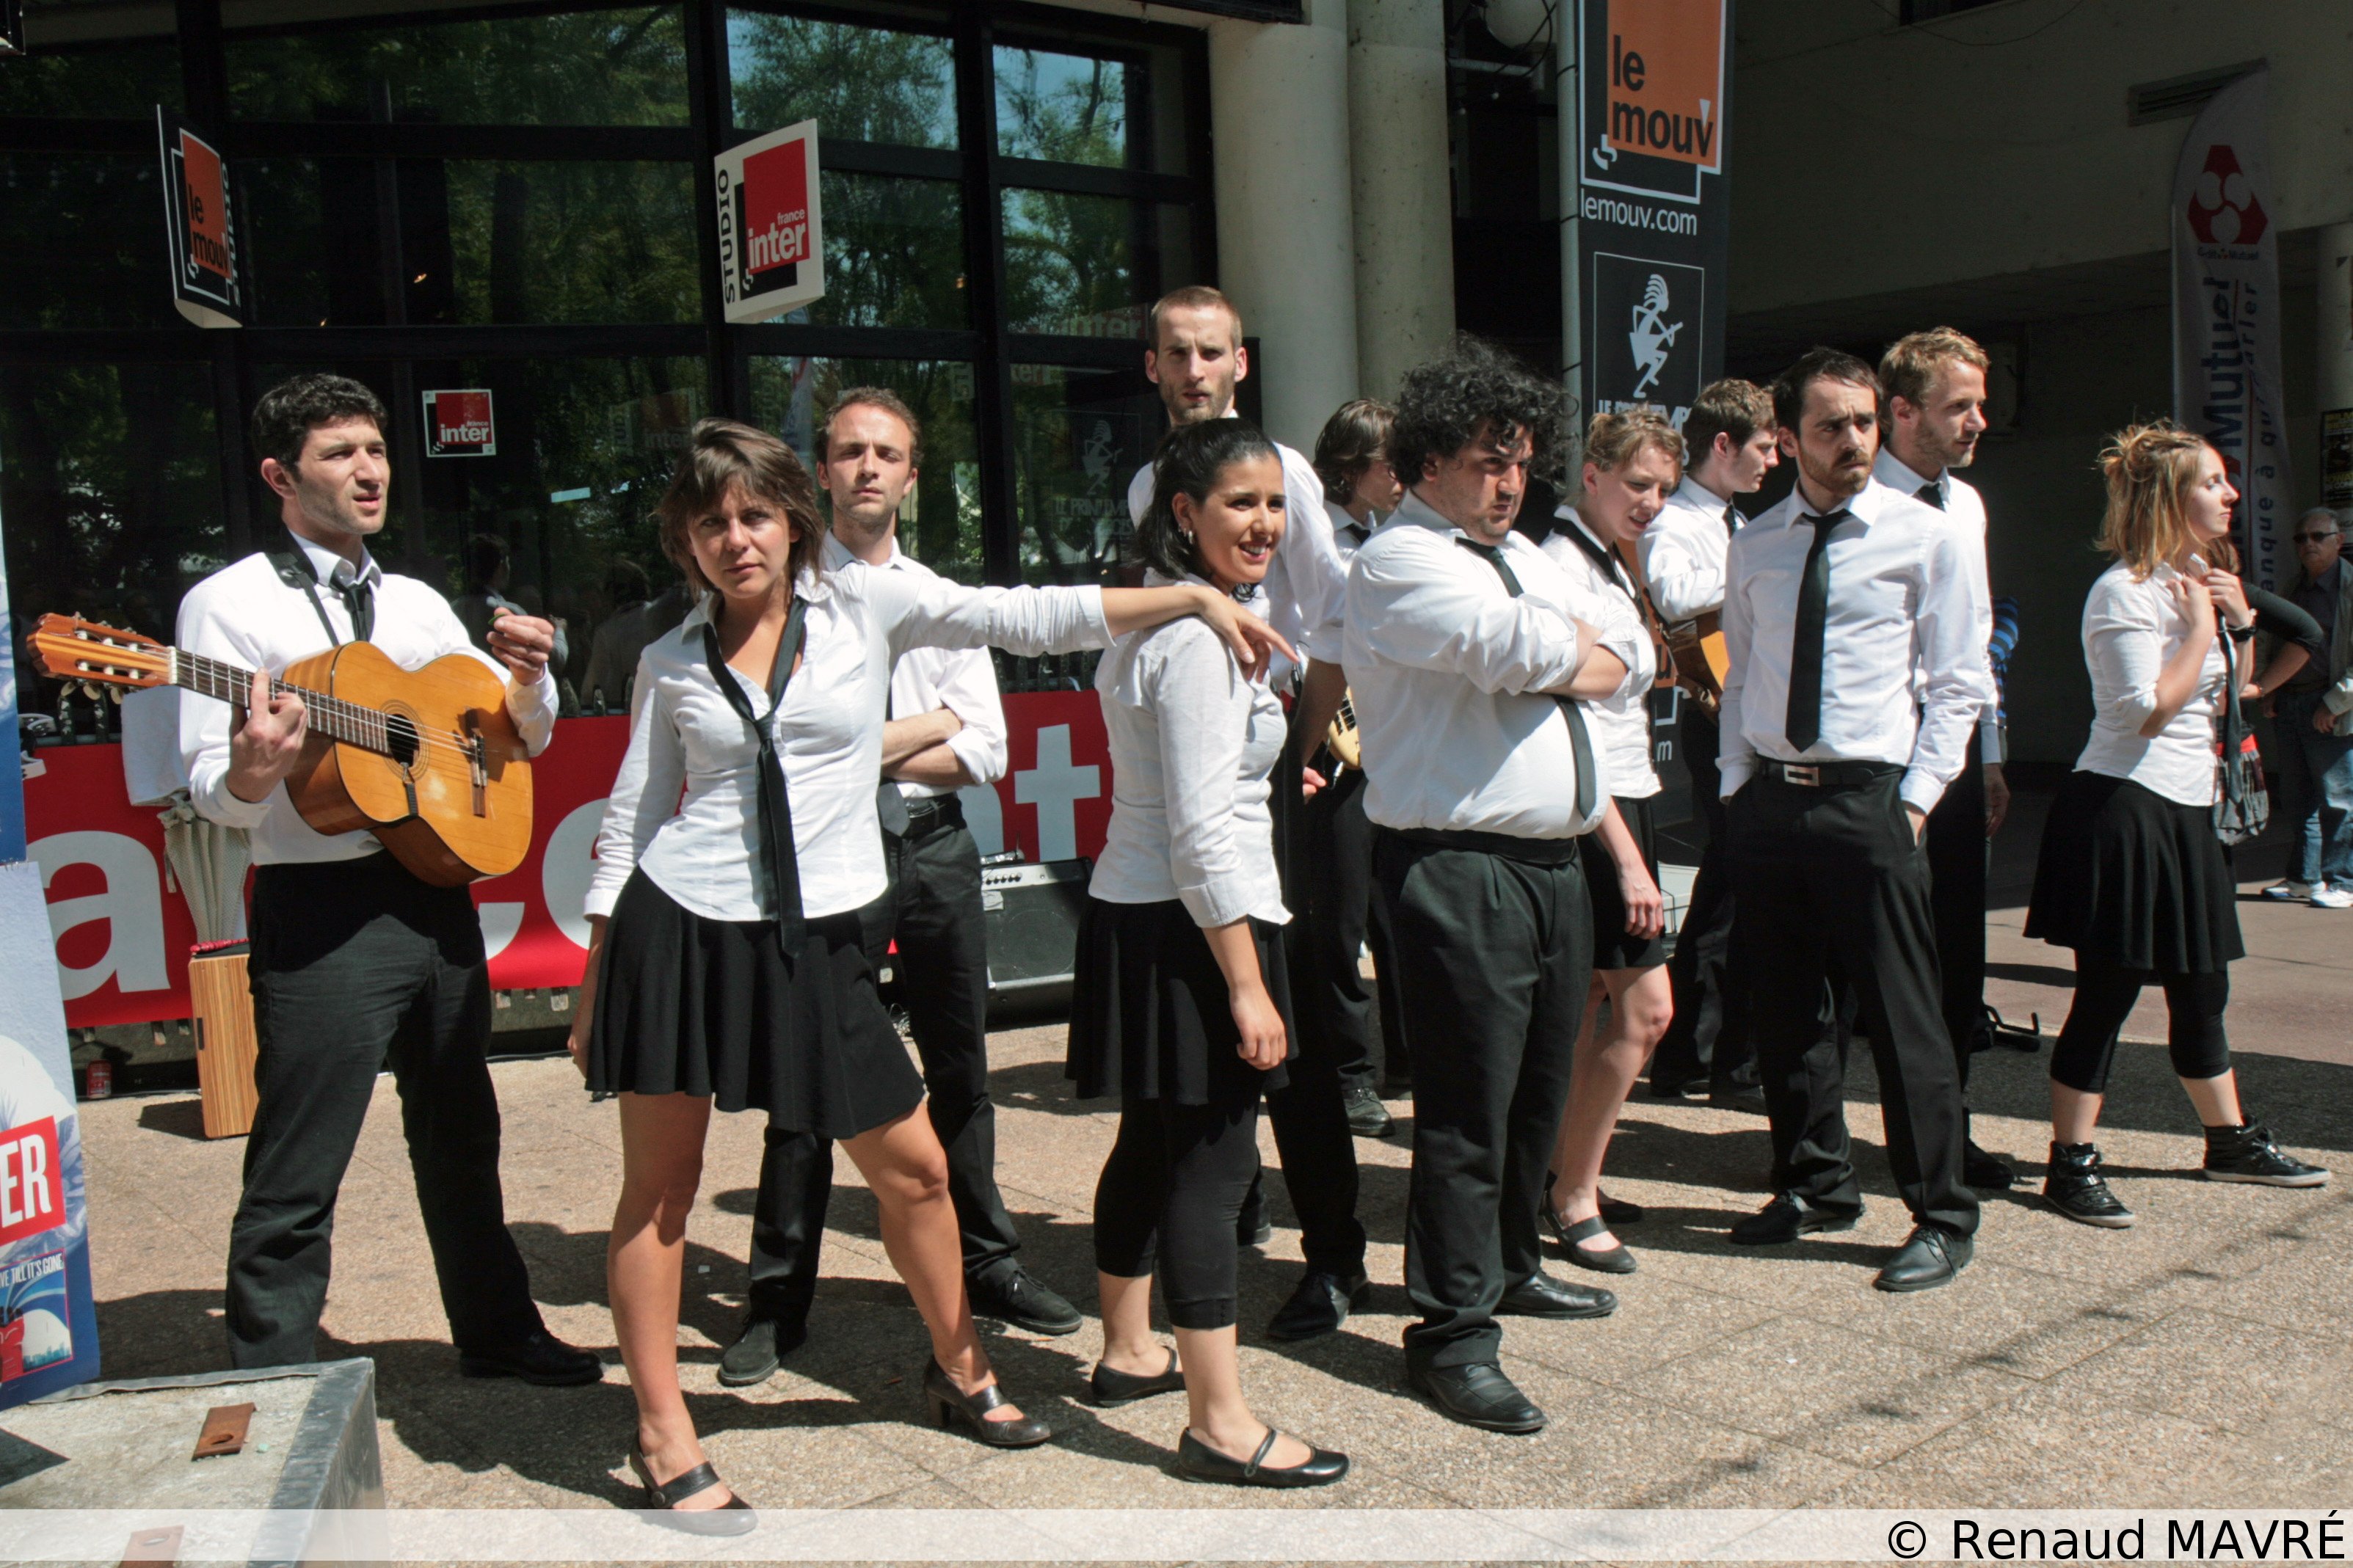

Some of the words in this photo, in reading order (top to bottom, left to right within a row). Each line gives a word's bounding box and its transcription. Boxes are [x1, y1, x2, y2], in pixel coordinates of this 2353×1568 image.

[1612, 34, 1645, 92] le
[188, 183, 205, 225] le
[777, 208, 805, 225] france
[1581, 188, 1698, 236] lemouv.com
[718, 169, 735, 304] STUDIO
[748, 222, 806, 270] inter
[2201, 277, 2244, 447] Mutuel
[440, 424, 490, 442] inter
[2258, 496, 2277, 592] anque
[11, 1265, 27, 1284] TILL
[27, 1259, 42, 1279] IT'S
[43, 1252, 64, 1275] GONE
